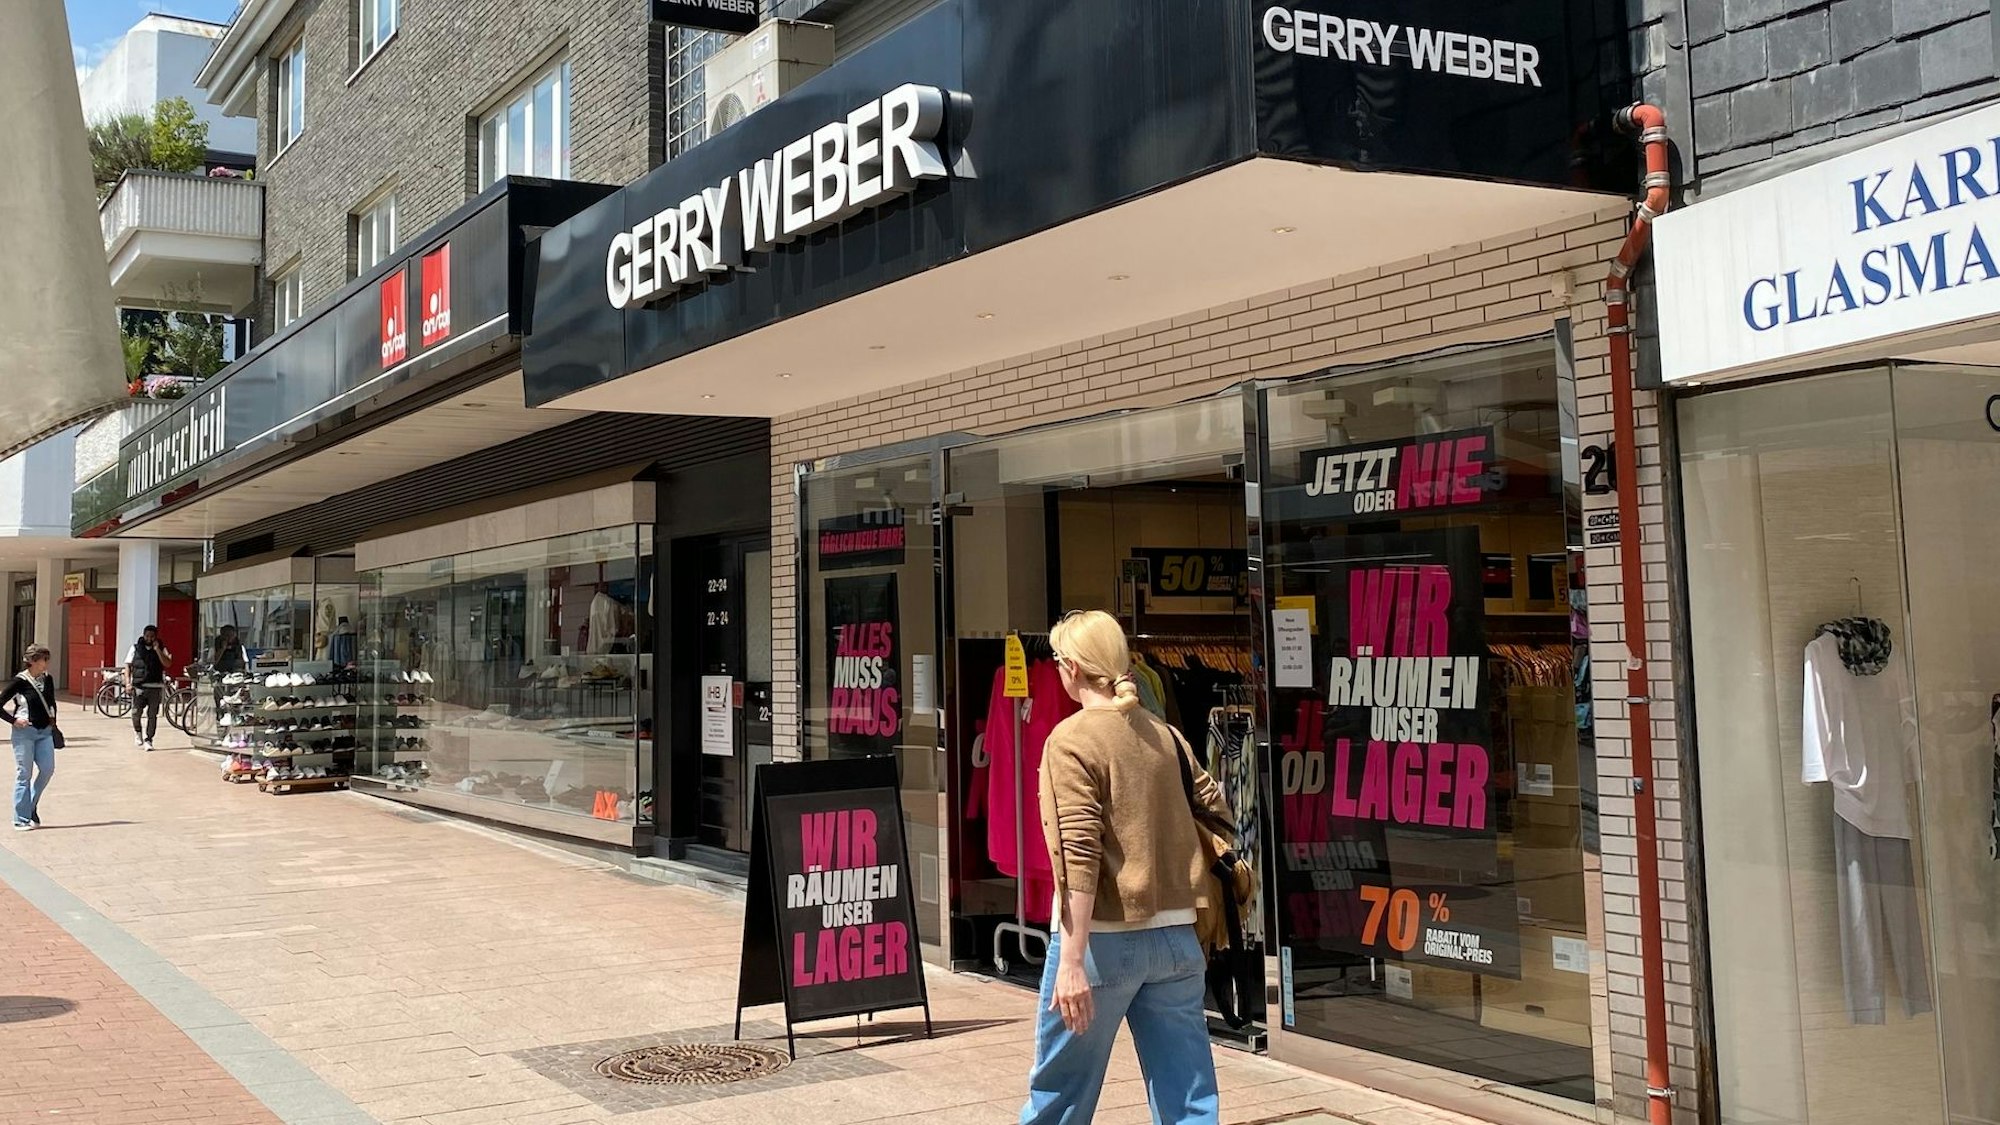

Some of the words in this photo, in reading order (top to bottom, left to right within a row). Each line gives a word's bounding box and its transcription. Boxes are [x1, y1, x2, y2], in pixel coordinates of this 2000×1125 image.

[1263, 6, 1399, 66] GERRY
[1406, 26, 1543, 88] WEBER
[606, 176, 735, 310] GERRY
[738, 82, 946, 252] WEBER
[1305, 446, 1397, 497] JETZT
[1397, 435, 1487, 510] NIE
[1354, 489, 1396, 515] ODER
[1160, 555, 1205, 591] 50
[1349, 565, 1451, 659] WIR
[836, 621, 892, 659] ALLES
[833, 655, 883, 690] MUSS
[1328, 645, 1479, 710] RÄUMEN
[829, 687, 898, 738] RAUS
[1370, 706, 1439, 744] UNSER
[1331, 738, 1490, 830] LAGER
[801, 809, 878, 873] WIR
[787, 864, 899, 909] RÄUMEN
[822, 901, 874, 929] UNSER
[1360, 884, 1420, 953] 70
[1428, 891, 1450, 923] %
[1426, 928, 1459, 946] RABATT
[1459, 931, 1480, 949] VOM
[792, 920, 909, 988] LAGER
[1423, 941, 1493, 965] ORIGINAL-PREIS
